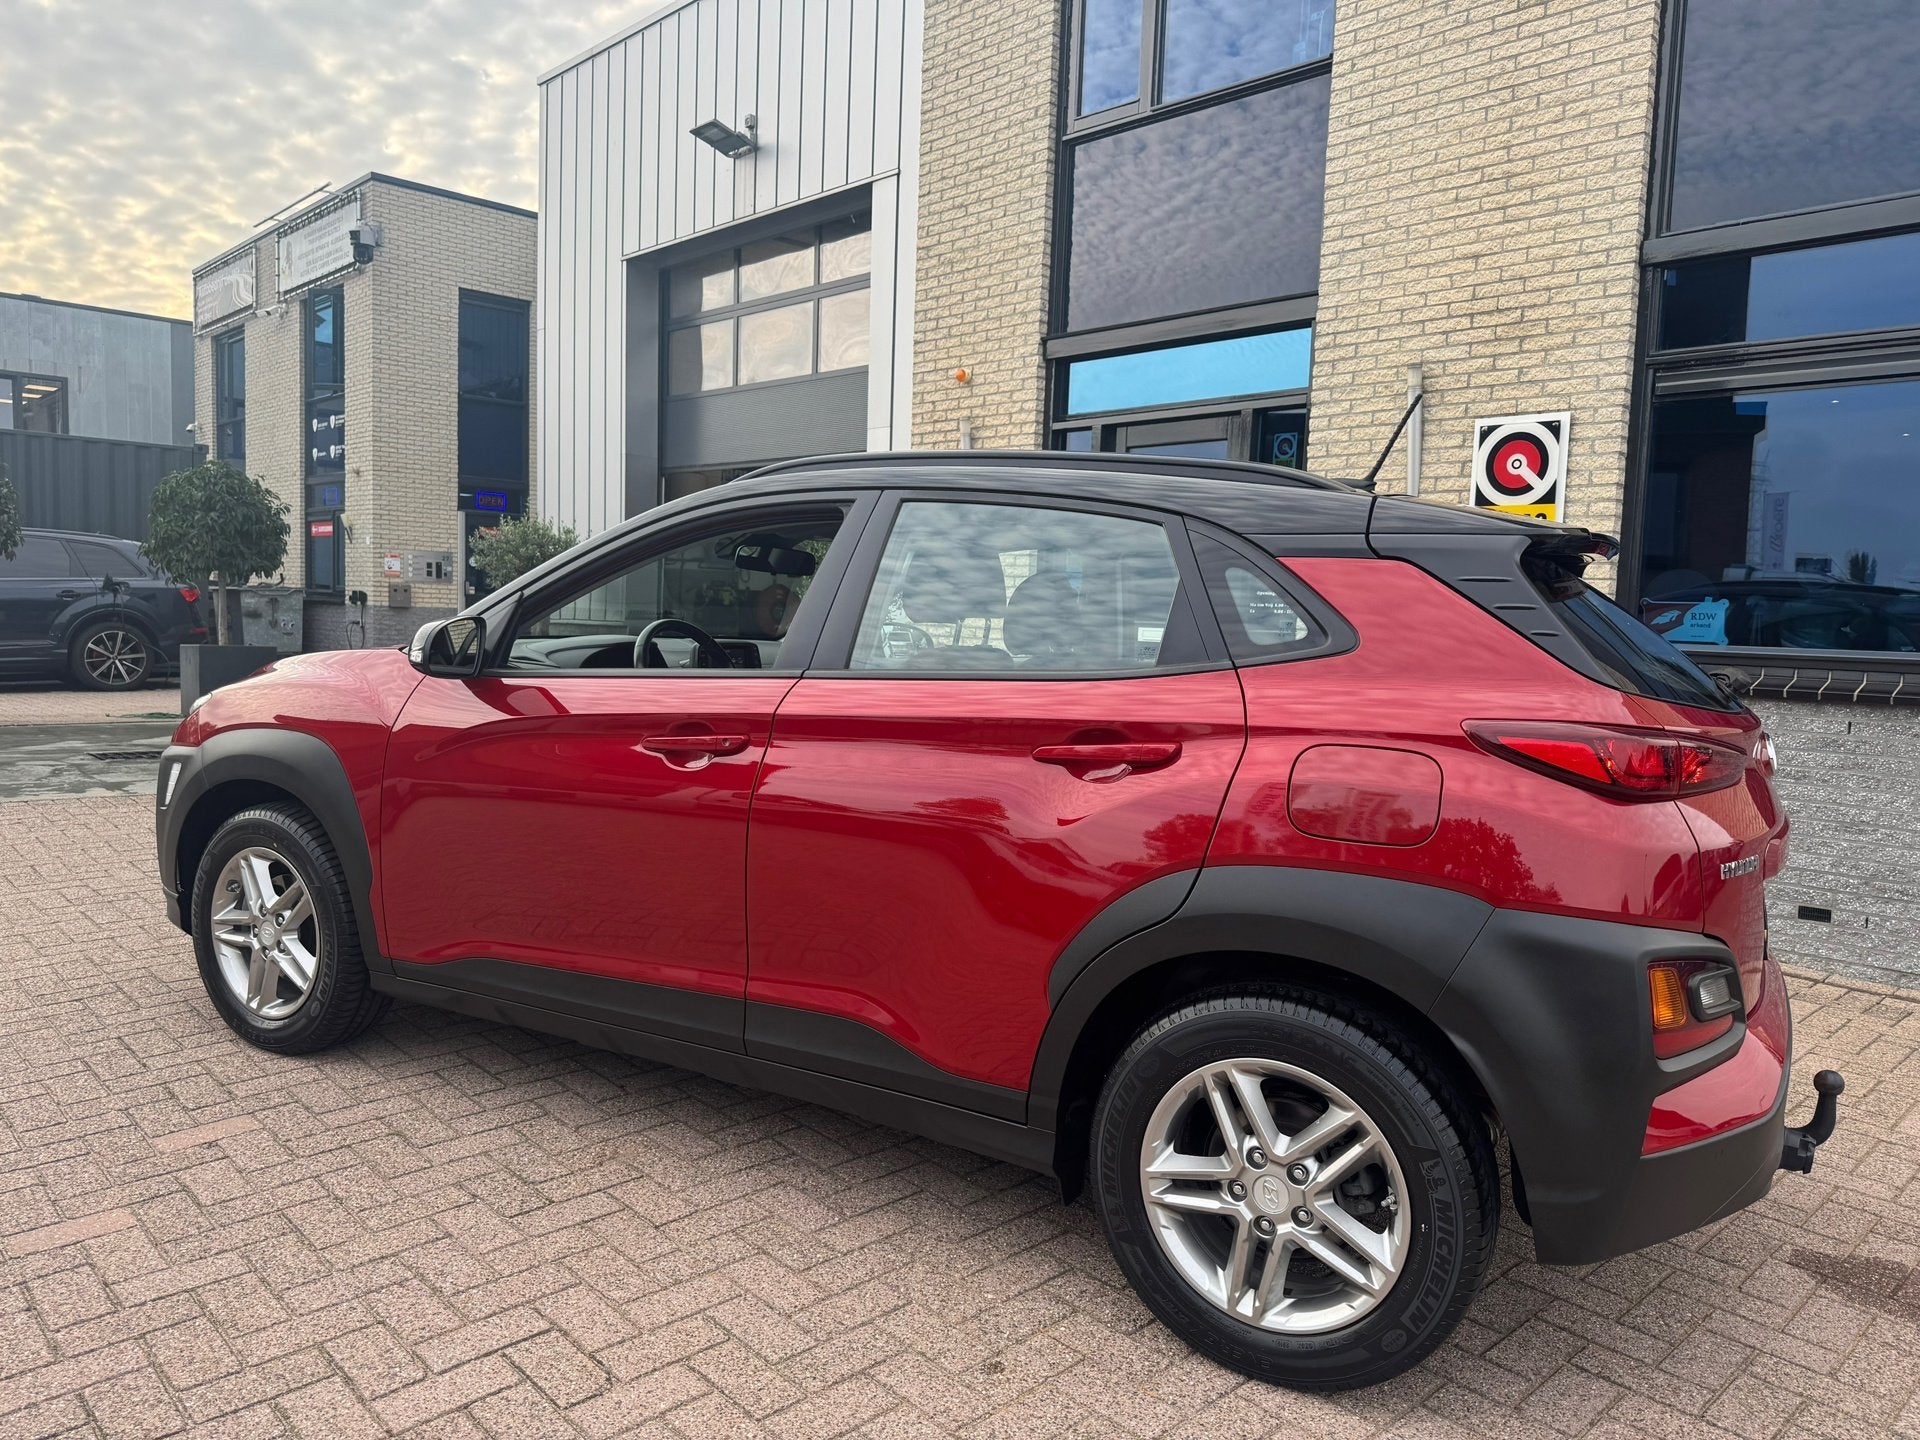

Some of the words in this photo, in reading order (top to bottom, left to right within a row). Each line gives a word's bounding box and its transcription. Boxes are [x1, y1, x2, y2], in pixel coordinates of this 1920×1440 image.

[479, 496, 504, 506] OPEN
[1690, 612, 1717, 621] RDW
[1102, 1074, 1139, 1197] MICHELIN
[1408, 1197, 1455, 1333] MICHELIN
